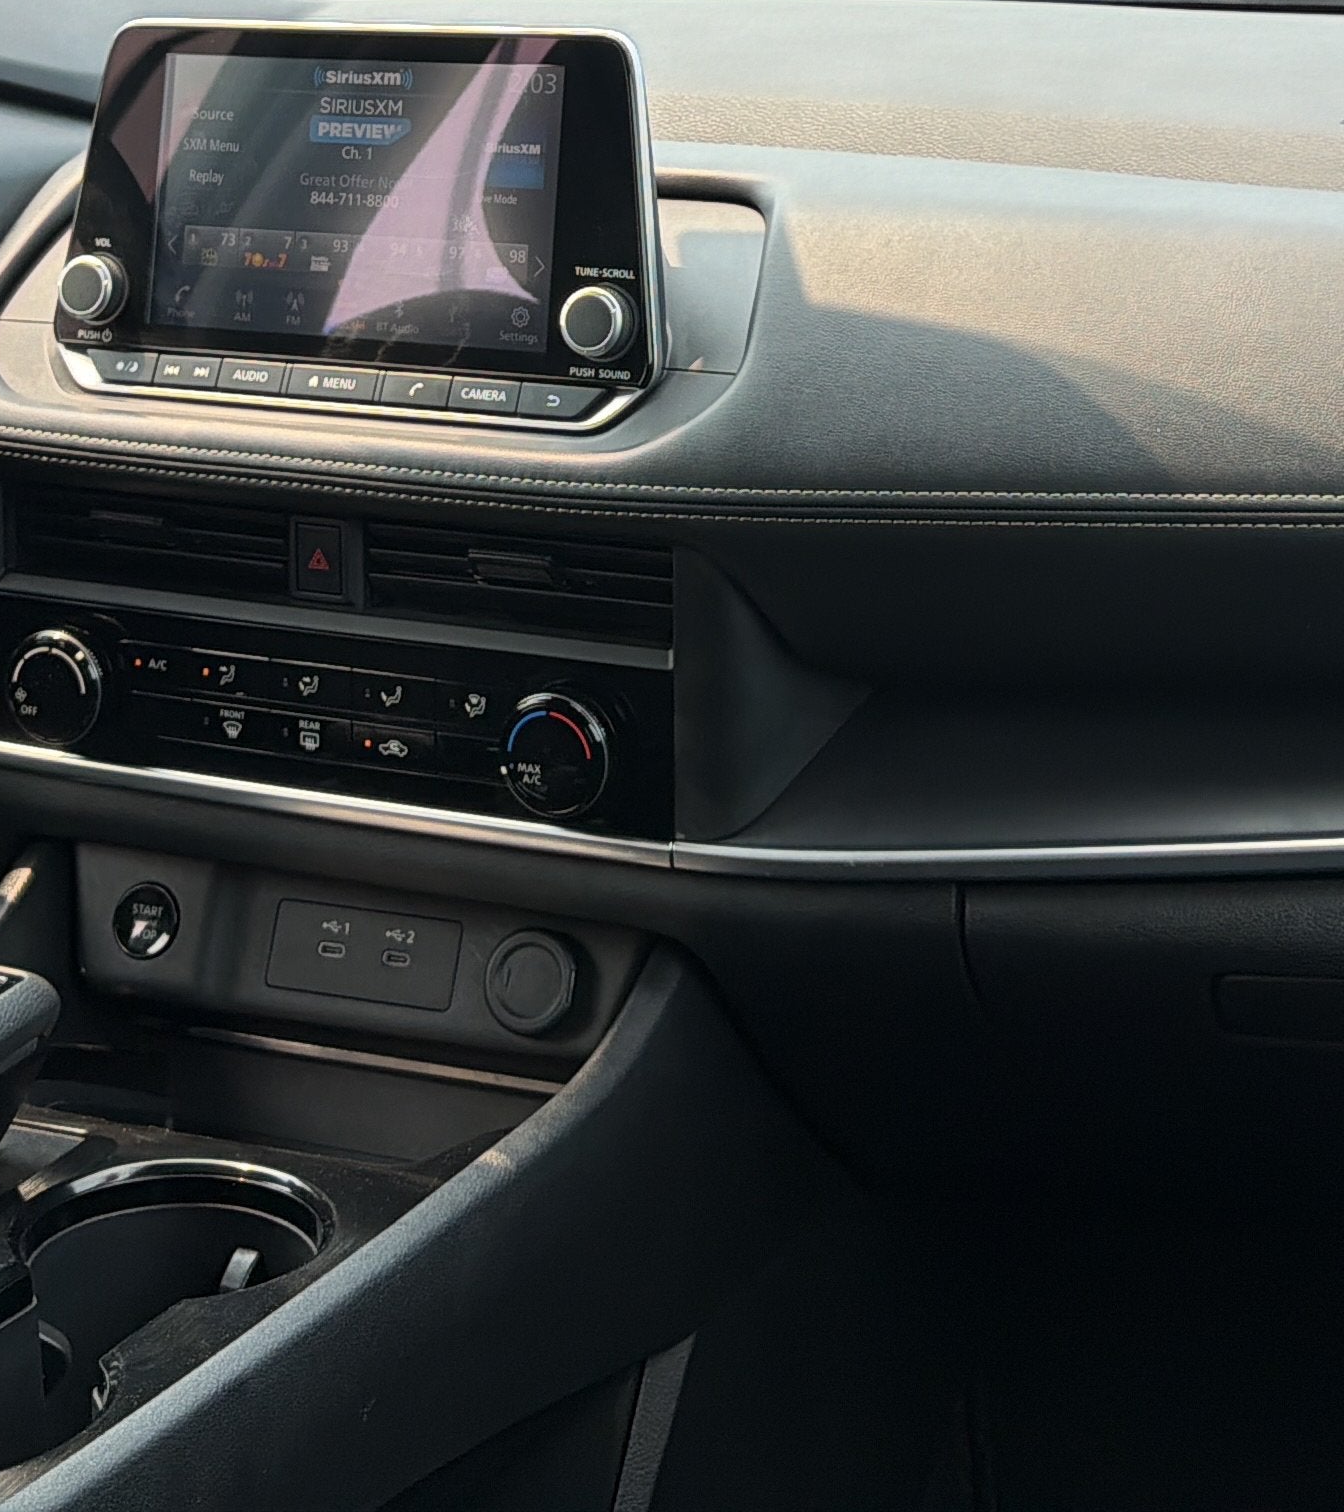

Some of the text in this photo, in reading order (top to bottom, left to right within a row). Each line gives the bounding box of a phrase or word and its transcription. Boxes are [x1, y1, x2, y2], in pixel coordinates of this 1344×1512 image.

[319, 96, 403, 116] SIRIUSXM
[192, 108, 235, 122] Source
[317, 121, 402, 140] PREVIEW
[182, 137, 240, 153] SXM Menu
[341, 145, 373, 160] Ch. 1
[189, 169, 225, 186] Replay
[299, 172, 376, 189] Great Offer
[309, 190, 399, 208] 844-711-8800
[94, 237, 113, 248] VOL
[220, 232, 236, 247] 73
[284, 236, 292, 250] 7
[332, 239, 349, 253] 93
[508, 249, 526, 264] 98
[76, 329, 101, 342] PUSH
[375, 320, 389, 333] BT
[390, 322, 420, 336] Audio
[498, 330, 539, 345] Settings
[232, 368, 269, 385] AUDIO
[569, 365, 631, 381] PUSH SOUND
[322, 376, 357, 392] MENU
[460, 386, 507, 404] CAMERA
[147, 658, 168, 672] A/C
[20, 704, 38, 717] OFF
[219, 708, 246, 721] FRONT
[298, 719, 321, 731] REAR
[517, 761, 542, 775] MAX
[522, 773, 542, 786] A/C
[132, 902, 164, 918] START
[406, 930, 416, 944] 2
